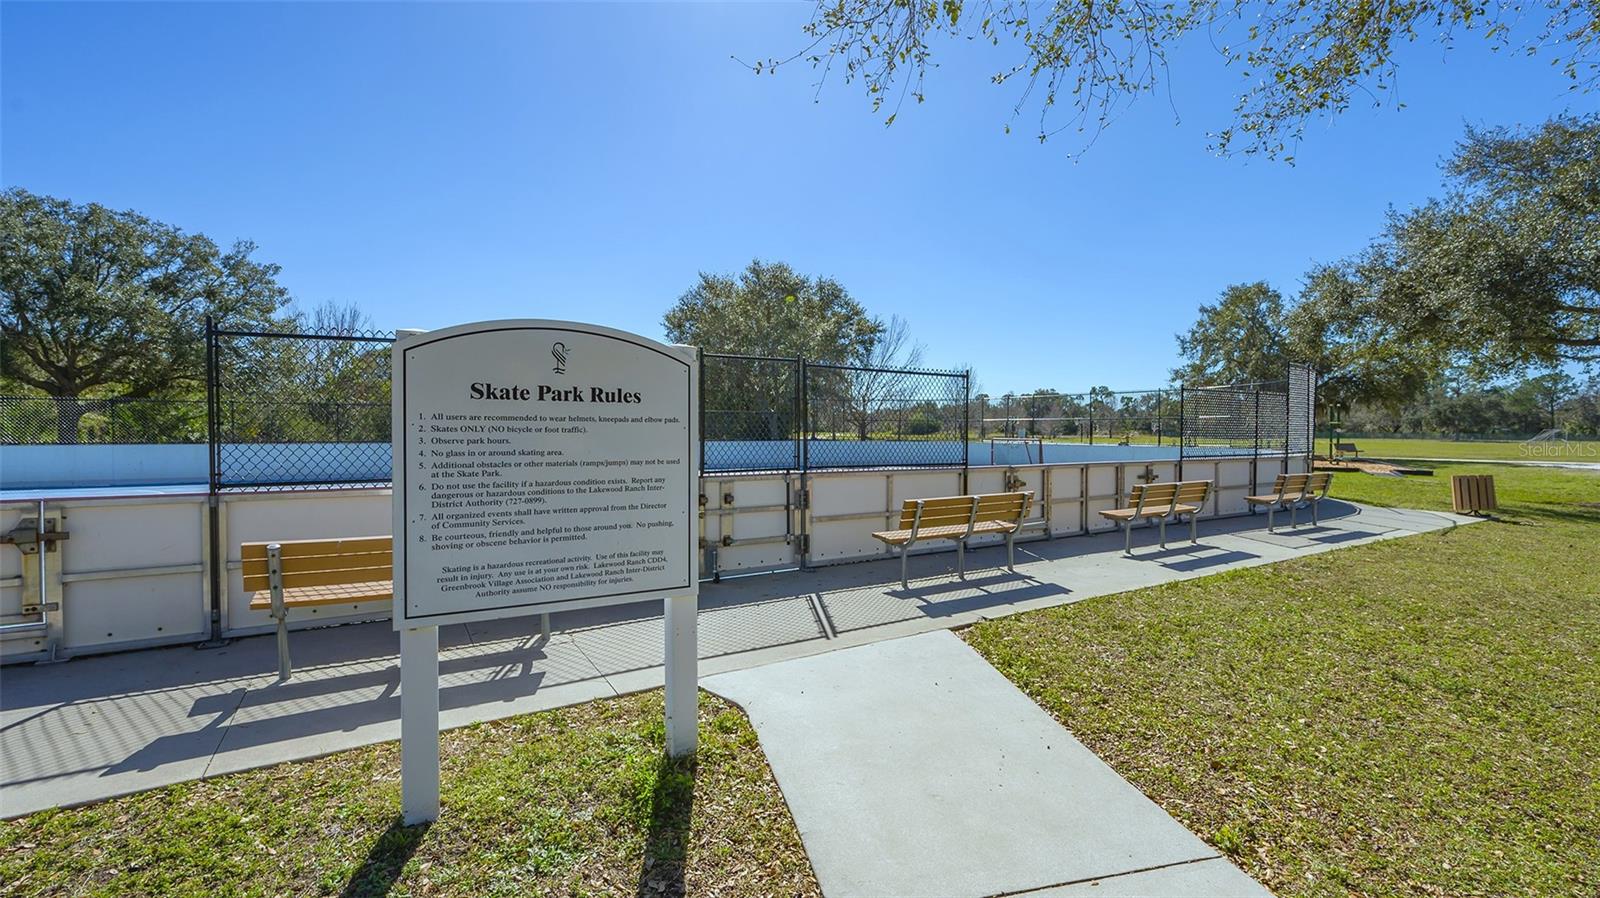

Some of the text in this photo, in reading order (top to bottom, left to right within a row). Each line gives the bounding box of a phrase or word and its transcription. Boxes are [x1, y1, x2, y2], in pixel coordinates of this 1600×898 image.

[470, 382, 642, 404] Skate Park Rules
[430, 491, 473, 500] dangerous
[465, 499, 503, 508] Authority
[505, 497, 546, 506] (727-0899).
[446, 511, 485, 520] organized
[579, 505, 608, 513] approval
[442, 520, 489, 530] Community
[444, 532, 486, 541] courteous,
[488, 529, 519, 538] friendly
[536, 527, 562, 535] helpful
[431, 542, 463, 551] shoving
[550, 534, 586, 543] permitted.
[441, 566, 471, 574] Skating
[525, 558, 565, 566] recreational
[440, 582, 485, 591] Greenbrook
[488, 579, 512, 588] Village
[515, 576, 554, 584] Association
[470, 572, 493, 580] injury.
[475, 589, 510, 598] Authority
[552, 580, 596, 590] responsibility
[608, 577, 633, 585] injuries.
